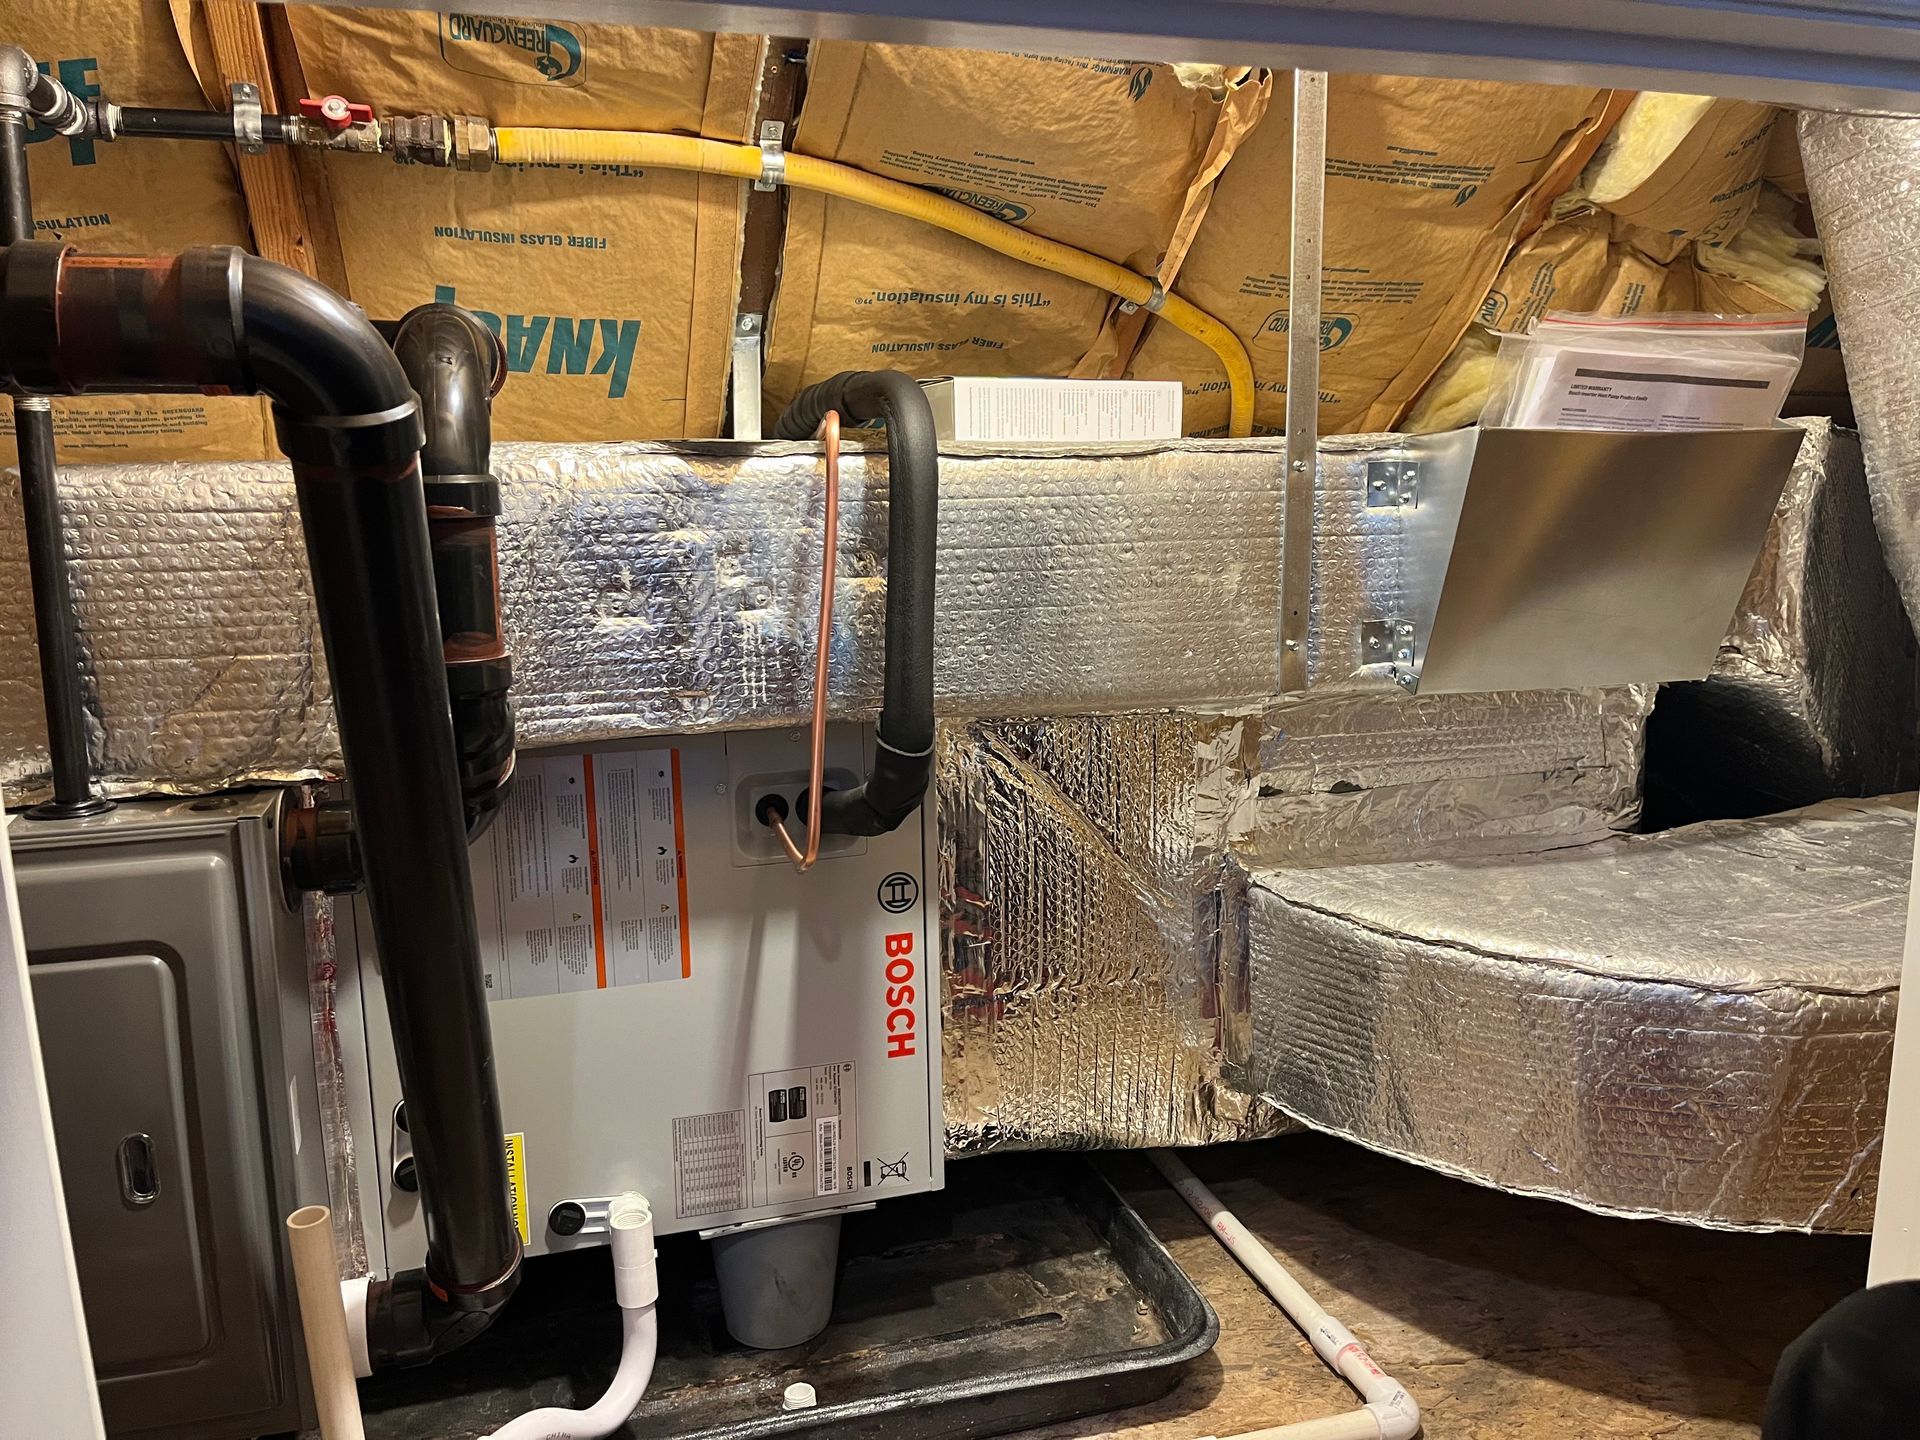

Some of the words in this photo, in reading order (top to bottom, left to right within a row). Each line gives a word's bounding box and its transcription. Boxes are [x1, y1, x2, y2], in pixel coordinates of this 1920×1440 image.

[449, 13, 582, 82] GREENGUARD
[1054, 56, 1075, 67] facing
[1076, 61, 1089, 69] This
[1091, 64, 1131, 76] WARNING:
[940, 189, 1027, 221] GREENGUA
[434, 226, 515, 244] INSULATION
[520, 234, 562, 247] GLASS
[566, 236, 607, 249] FIBER
[963, 291, 989, 305] my
[993, 294, 1008, 308] is
[1011, 292, 1051, 308] “This
[871, 341, 935, 354] INSULATION
[970, 337, 1004, 350] FIBER
[884, 932, 916, 1059] BOSCH
